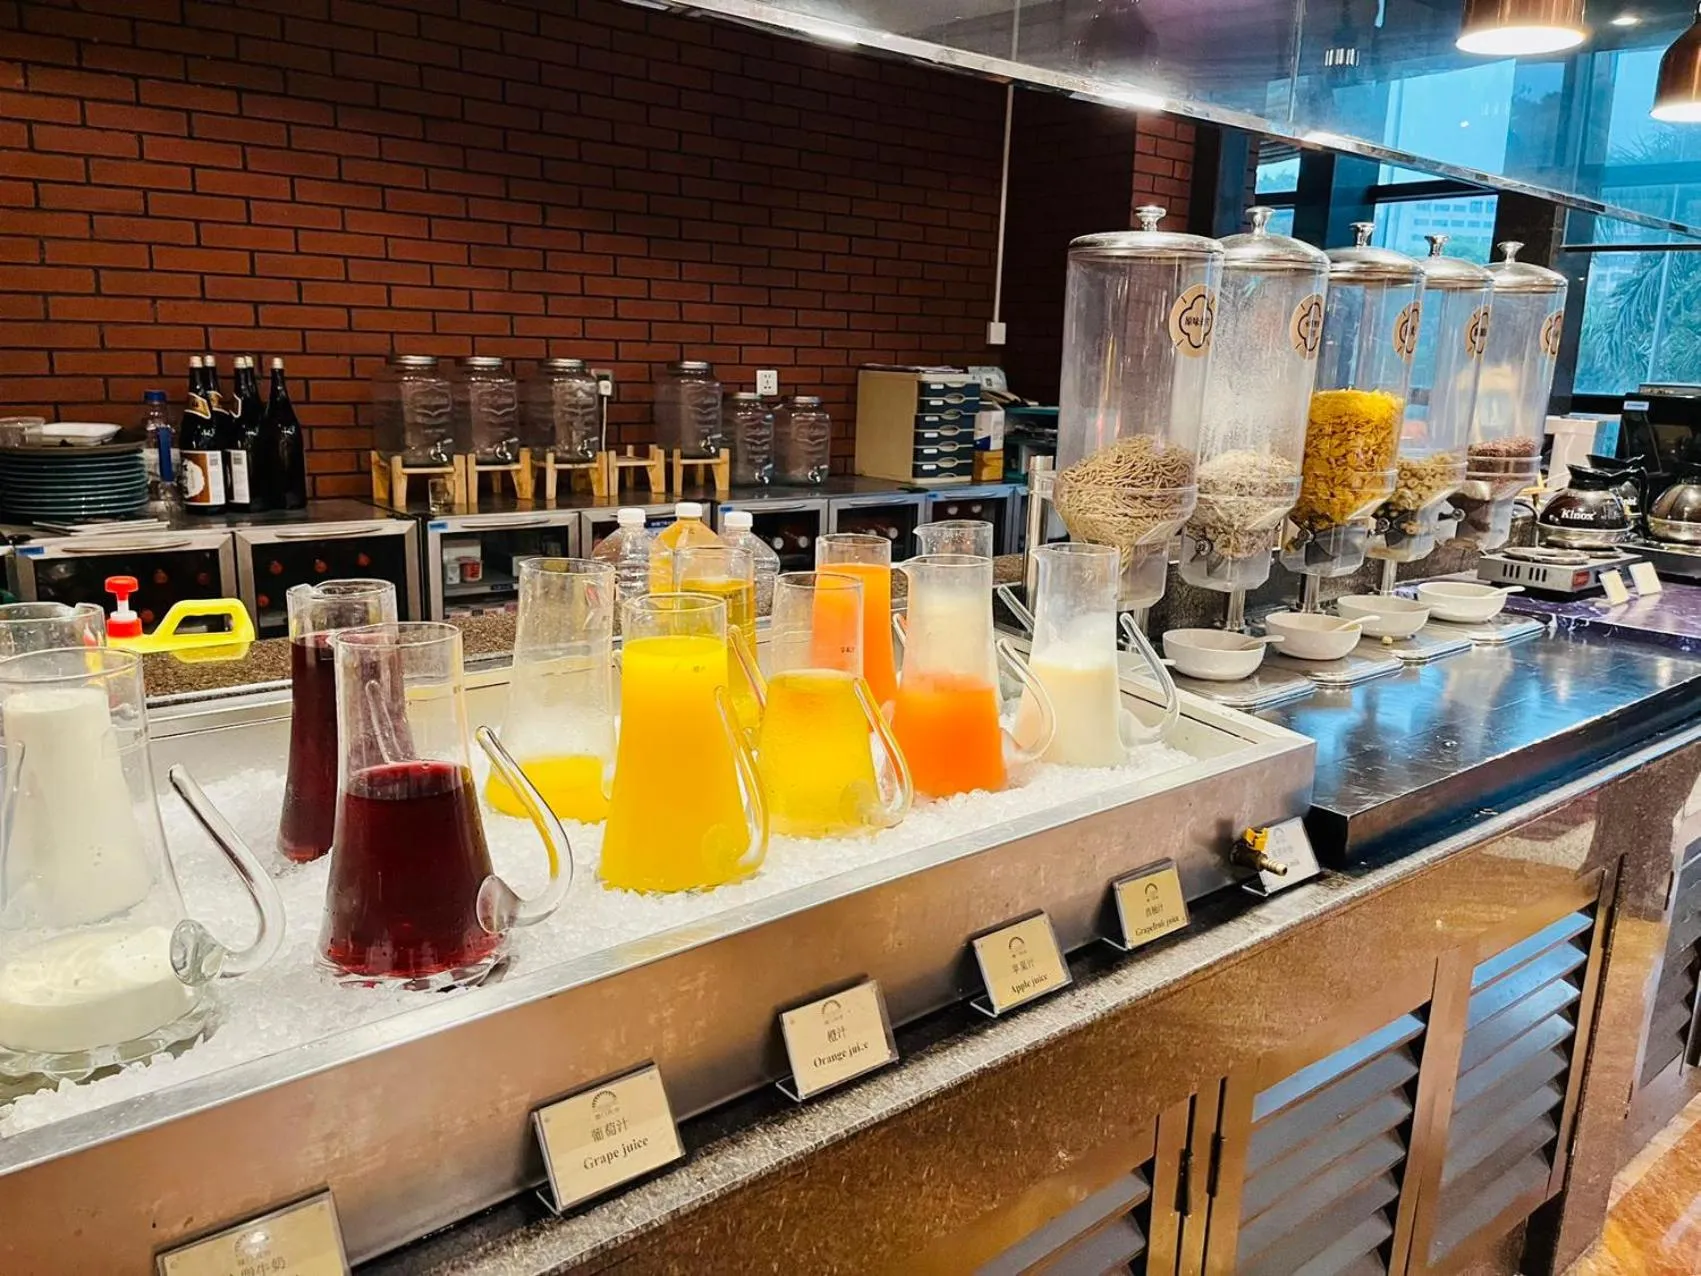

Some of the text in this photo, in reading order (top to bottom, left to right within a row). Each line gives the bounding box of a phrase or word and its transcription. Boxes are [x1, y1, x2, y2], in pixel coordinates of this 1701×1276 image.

[1560, 508, 1597, 521] Kinox
[1011, 979, 1031, 995] Apple
[813, 1049, 847, 1069] Orange
[591, 1118, 627, 1143] 葡萄汁
[583, 1136, 649, 1170] Grape juice
